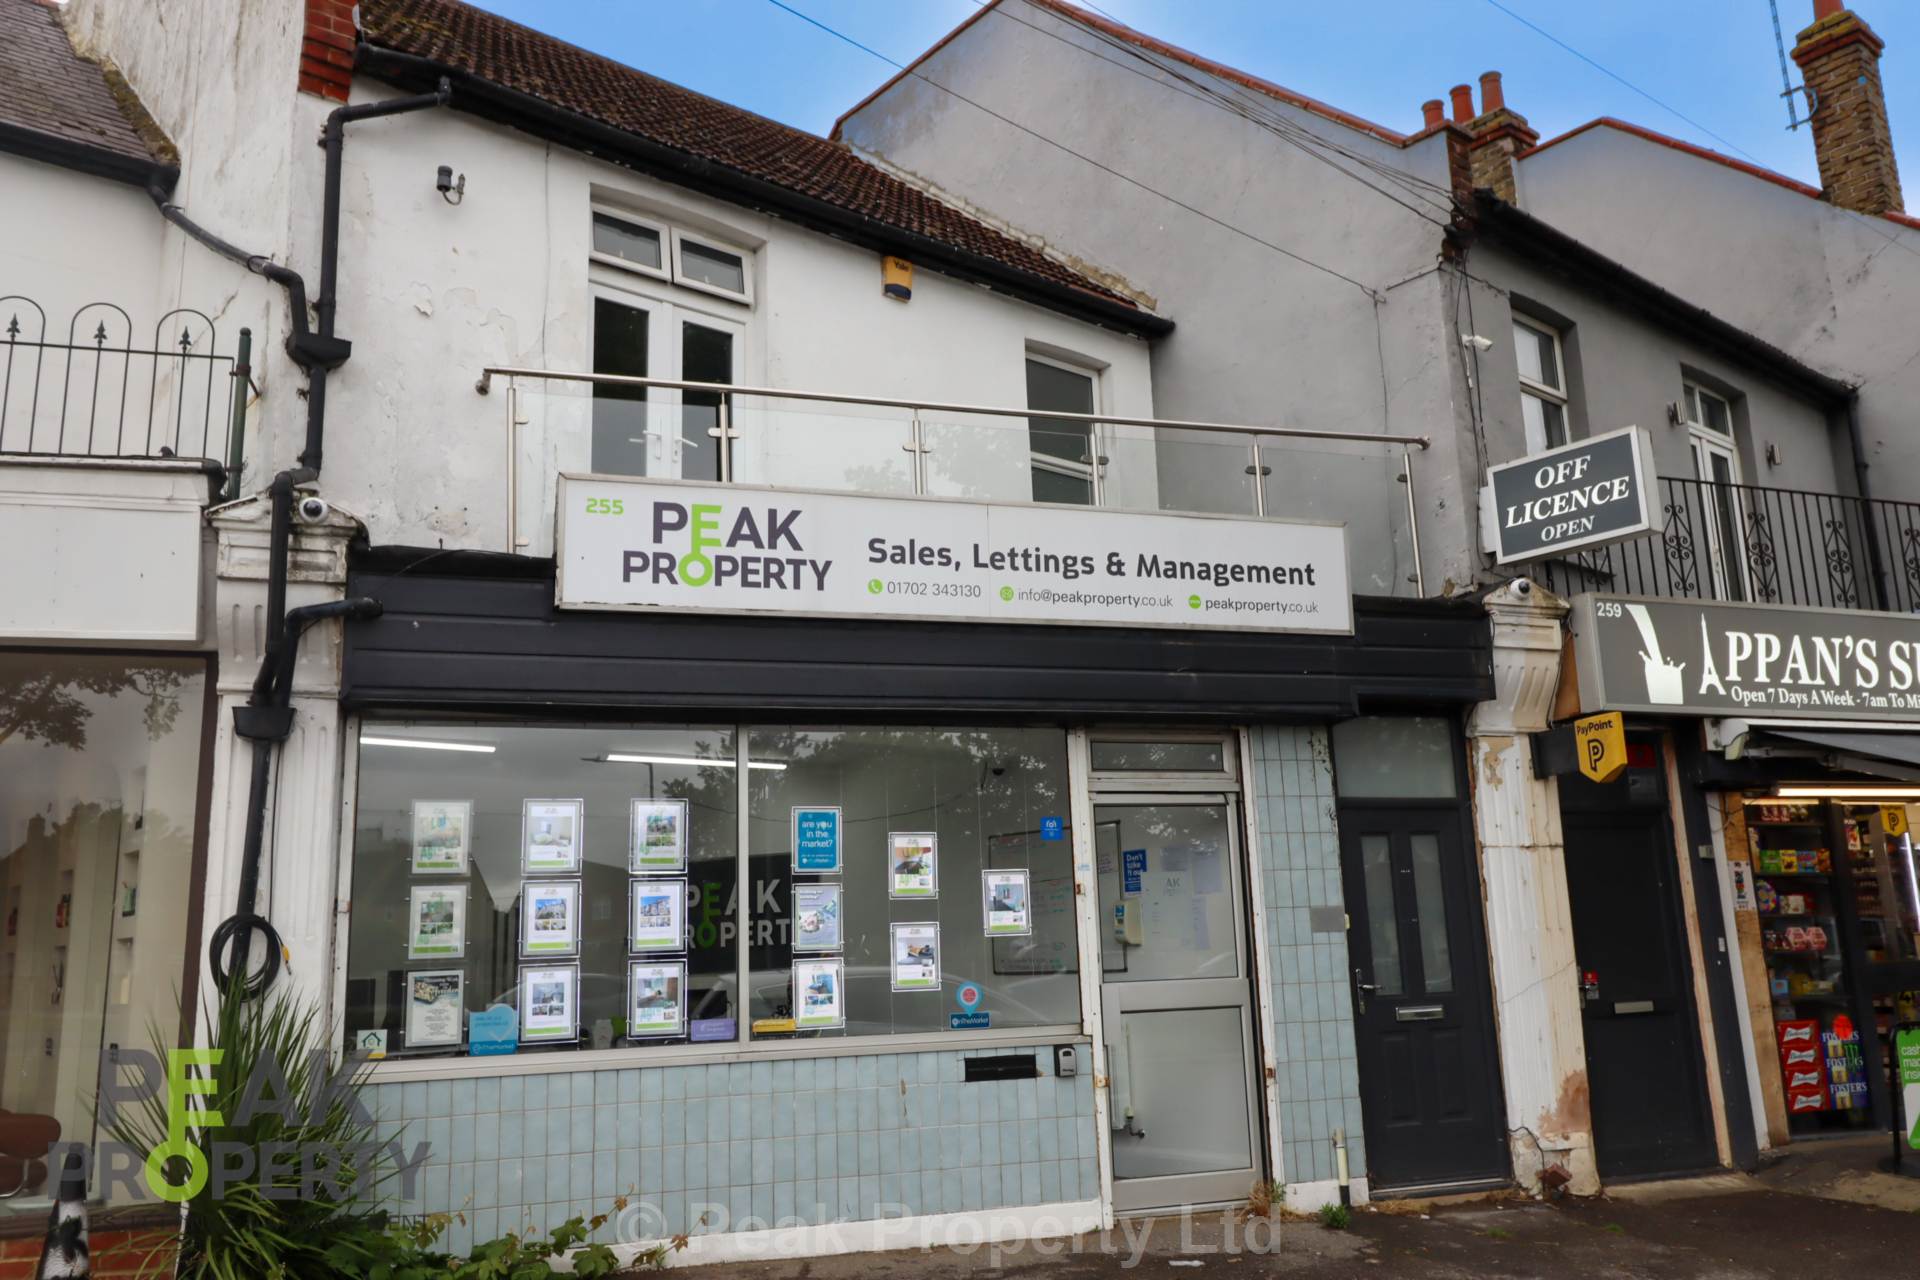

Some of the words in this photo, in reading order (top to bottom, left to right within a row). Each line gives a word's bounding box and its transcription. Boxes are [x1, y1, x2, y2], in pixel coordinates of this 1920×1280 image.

[1534, 455, 1591, 489] OFF
[585, 498, 624, 515] 255
[1505, 476, 1630, 528] LICENCE
[653, 501, 803, 551] PEAK
[1541, 515, 1595, 541] OPEN
[622, 550, 832, 591] PROPERTY
[868, 538, 961, 571] Sales,
[973, 543, 1095, 580] Lettings
[1106, 552, 1126, 577] &
[1136, 553, 1316, 587] Management
[887, 581, 927, 596] 01702
[932, 583, 981, 598] 343130
[1018, 588, 1173, 608] info@peakproperty.co.uk
[1205, 596, 1319, 614] peakproperty.co.uk
[1596, 602, 1622, 618] 259
[1731, 685, 1766, 706] Open
[1767, 688, 1776, 703] 7
[1778, 687, 1808, 708] Days
[1810, 693, 1820, 705] A
[1821, 690, 1856, 706] Week
[1862, 692, 1888, 708] 7am
[1888, 693, 1905, 708] To
[1576, 720, 1613, 736] PayPoint
[802, 821, 815, 829] are
[815, 830, 829, 838] the
